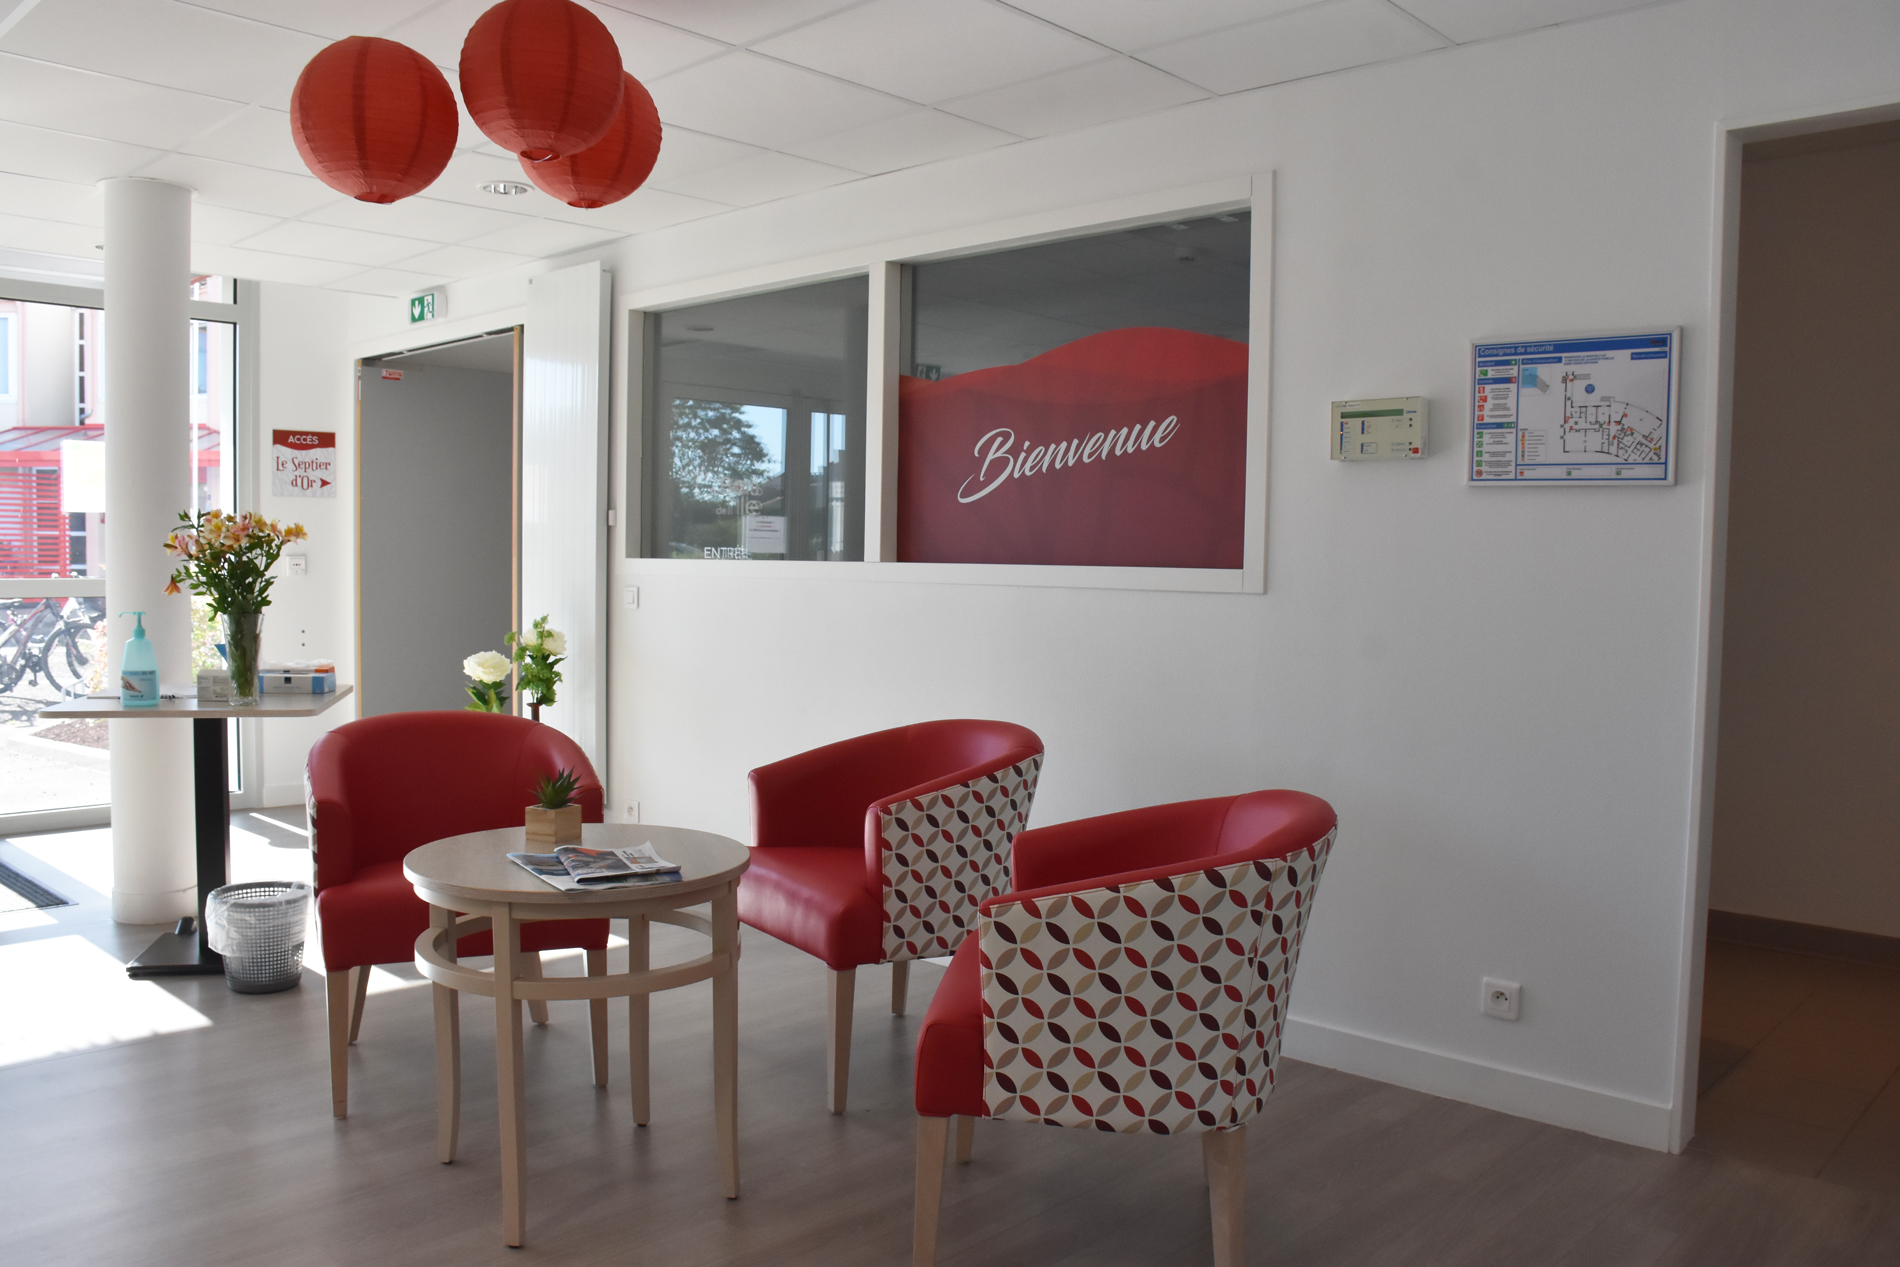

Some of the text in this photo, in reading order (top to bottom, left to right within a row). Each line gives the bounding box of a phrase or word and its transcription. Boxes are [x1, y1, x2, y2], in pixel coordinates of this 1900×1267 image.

[1480, 347, 1516, 355] Consignes
[1526, 345, 1554, 353] sécurité
[288, 434, 319, 445] ACCÈS
[275, 456, 331, 473] Le Septier
[957, 414, 1181, 504] Bienvenue
[291, 474, 317, 491] d'Or
